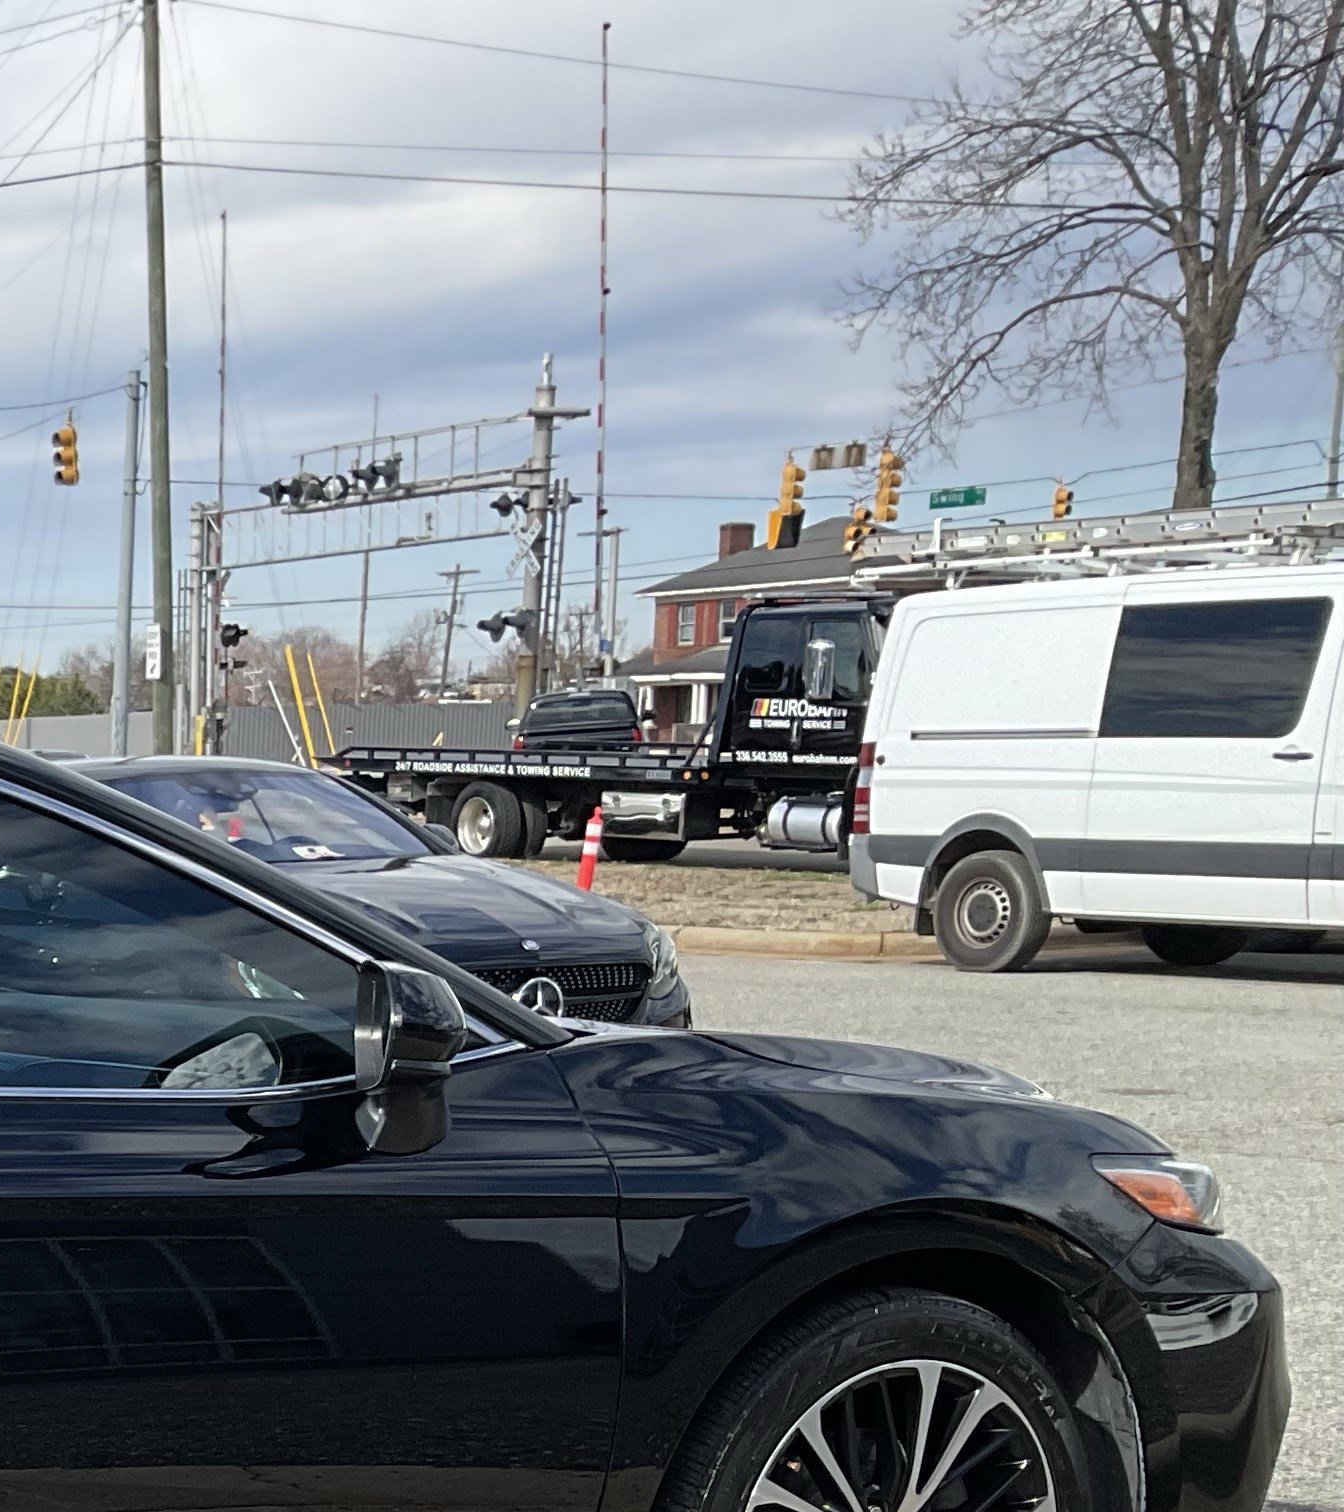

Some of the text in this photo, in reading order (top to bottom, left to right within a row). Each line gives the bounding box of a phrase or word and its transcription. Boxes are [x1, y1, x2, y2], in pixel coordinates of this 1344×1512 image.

[763, 720, 831, 729] TOWING SERVICE
[395, 761, 591, 777] 24/7 ROADSIDE ASSISTANCE & TOWING SERVICE
